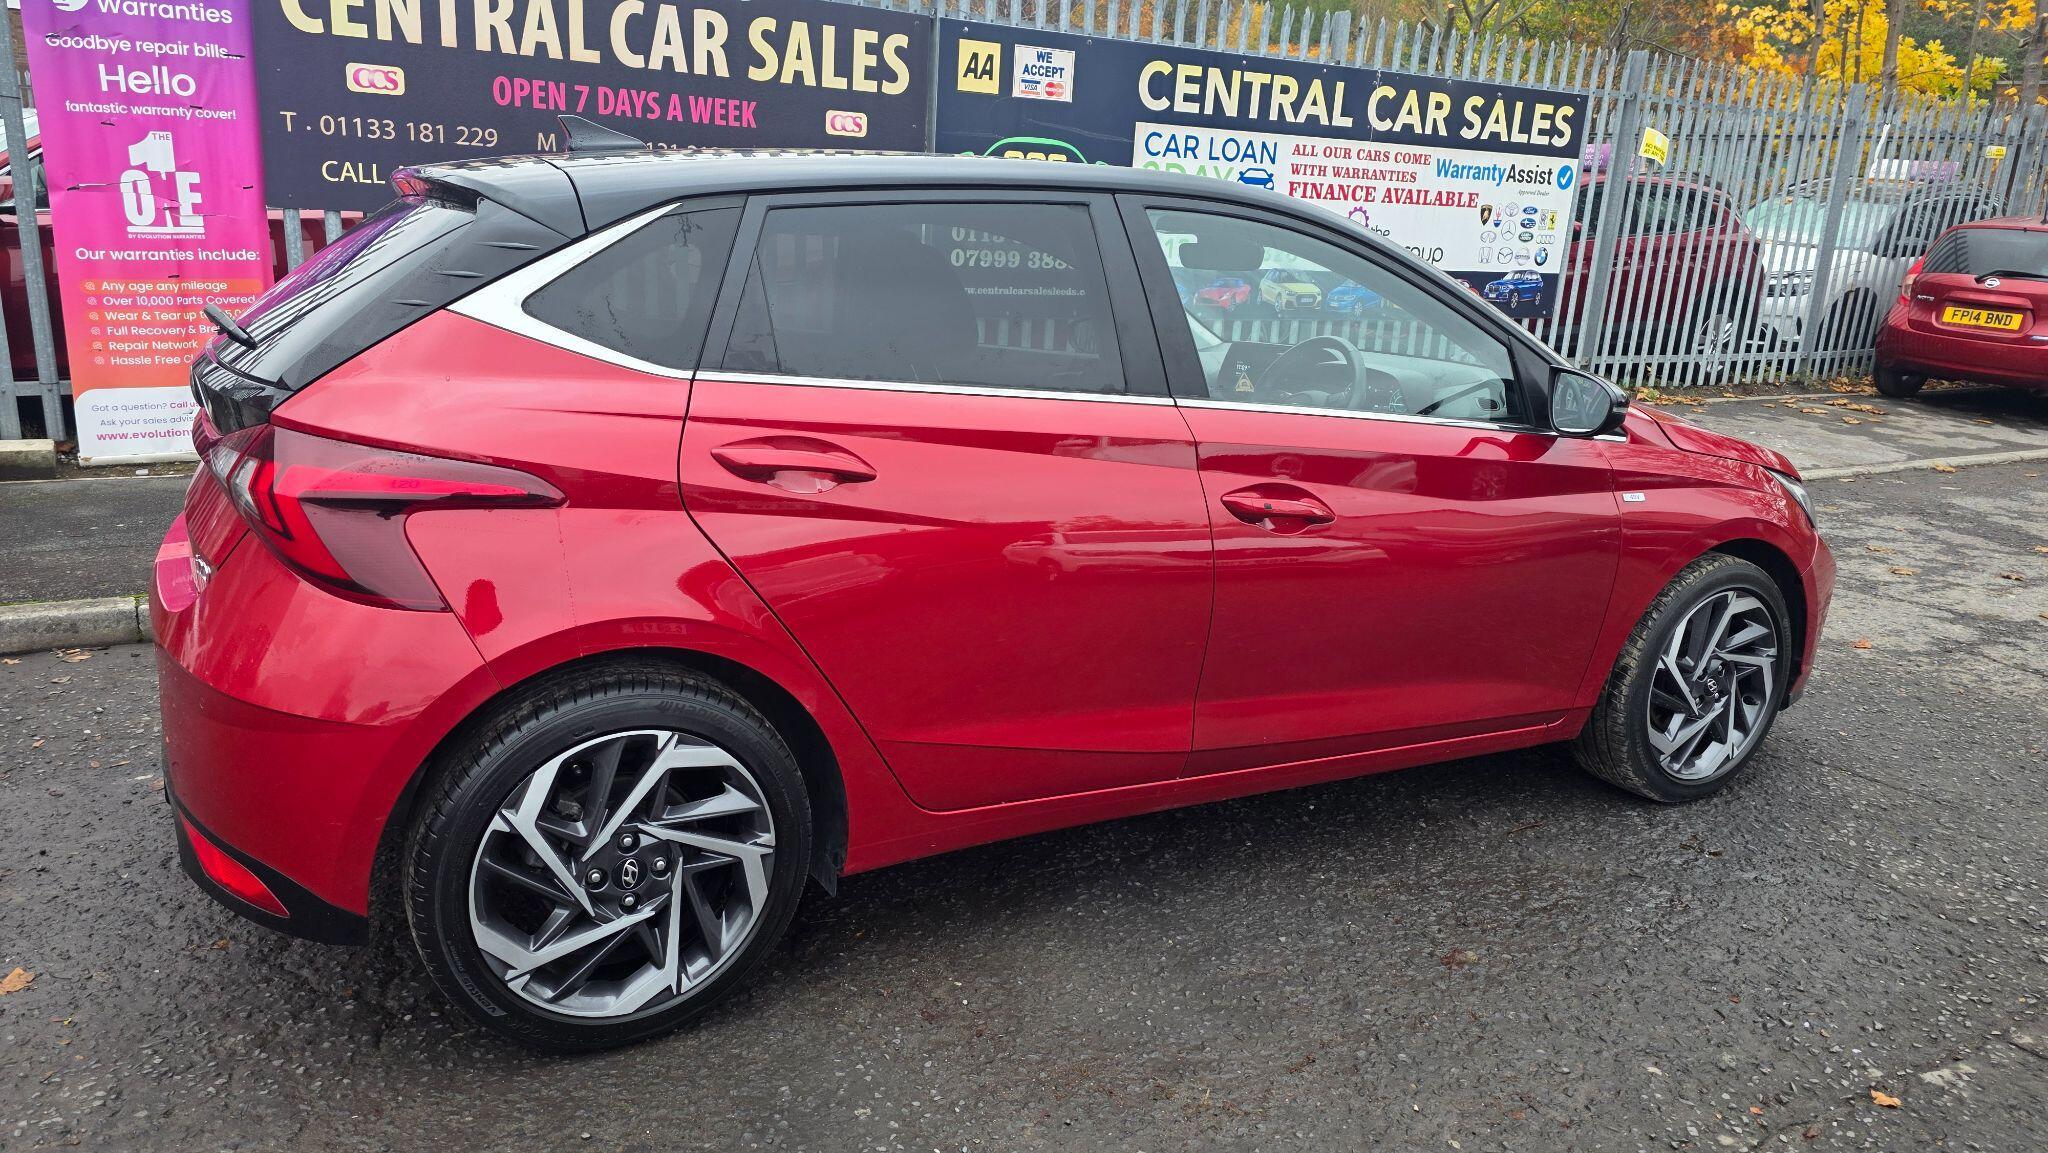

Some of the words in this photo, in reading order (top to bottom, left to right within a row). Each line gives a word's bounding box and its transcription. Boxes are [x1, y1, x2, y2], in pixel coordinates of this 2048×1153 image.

[98, 0, 233, 24] Warranties
[46, 33, 131, 54] Goodbye
[136, 40, 189, 57] repair
[609, 0, 730, 78] CAR
[747, 16, 910, 95] SALES
[962, 51, 994, 81] AA
[1036, 50, 1053, 64] WE
[98, 63, 196, 97] Hello
[1022, 64, 1065, 79] ACCEPT
[1024, 83, 1038, 91] VISA
[65, 100, 127, 114] fantastic
[130, 106, 192, 120] warranty
[195, 108, 237, 120] cover!
[492, 75, 566, 111] OPEN
[574, 85, 590, 112] 7
[597, 86, 661, 120] DAYS
[667, 93, 683, 122] A
[688, 95, 758, 128] WEEK
[1138, 60, 1354, 128] CENTRAL
[1367, 85, 1451, 137] CAR
[1459, 94, 1575, 148] SALES
[151, 132, 171, 141] THE
[320, 114, 396, 140] 01133
[406, 122, 445, 144] 181
[455, 126, 498, 147] 229
[1144, 130, 1200, 159] CAR
[1209, 136, 1279, 165] LOAN
[1292, 143, 1318, 158] ALL
[1322, 145, 1351, 160] OUR
[1356, 148, 1390, 164] CARS
[1394, 151, 1431, 166] COME
[321, 160, 386, 184] CALL
[1290, 163, 1328, 177] WITH
[1332, 165, 1417, 184] WARRANTIES
[1288, 181, 1376, 203] FINANCE
[1381, 186, 1479, 209] AVAILABLE
[75, 247, 106, 261] Our
[109, 248, 194, 261] warranties
[198, 247, 260, 261] include:
[950, 248, 1020, 268] 07999
[101, 281, 125, 293] Any
[128, 282, 153, 293] age
[156, 282, 179, 293] any
[181, 280, 228, 292] mileage
[103, 296, 133, 306] Over
[136, 296, 174, 307] 10,000
[177, 296, 203, 305] Parts
[206, 294, 256, 304] Covered
[105, 311, 139, 321] Wear
[141, 311, 151, 321] &
[154, 311, 181, 321] Tear
[183, 312, 197, 323] up
[1952, 309, 1981, 322] FP14
[1985, 312, 2013, 326] BND
[107, 325, 129, 335] Full
[131, 325, 186, 337] Recovery
[188, 325, 197, 334] &
[109, 341, 149, 352] Repair
[152, 339, 199, 350] Network
[111, 355, 151, 365] Hassle
[155, 355, 181, 364] Free
[91, 404, 110, 412] Got
[121, 403, 167, 412] question?
[169, 401, 188, 409] Call
[119, 418, 141, 427] your
[96, 428, 193, 440] www.evolution
